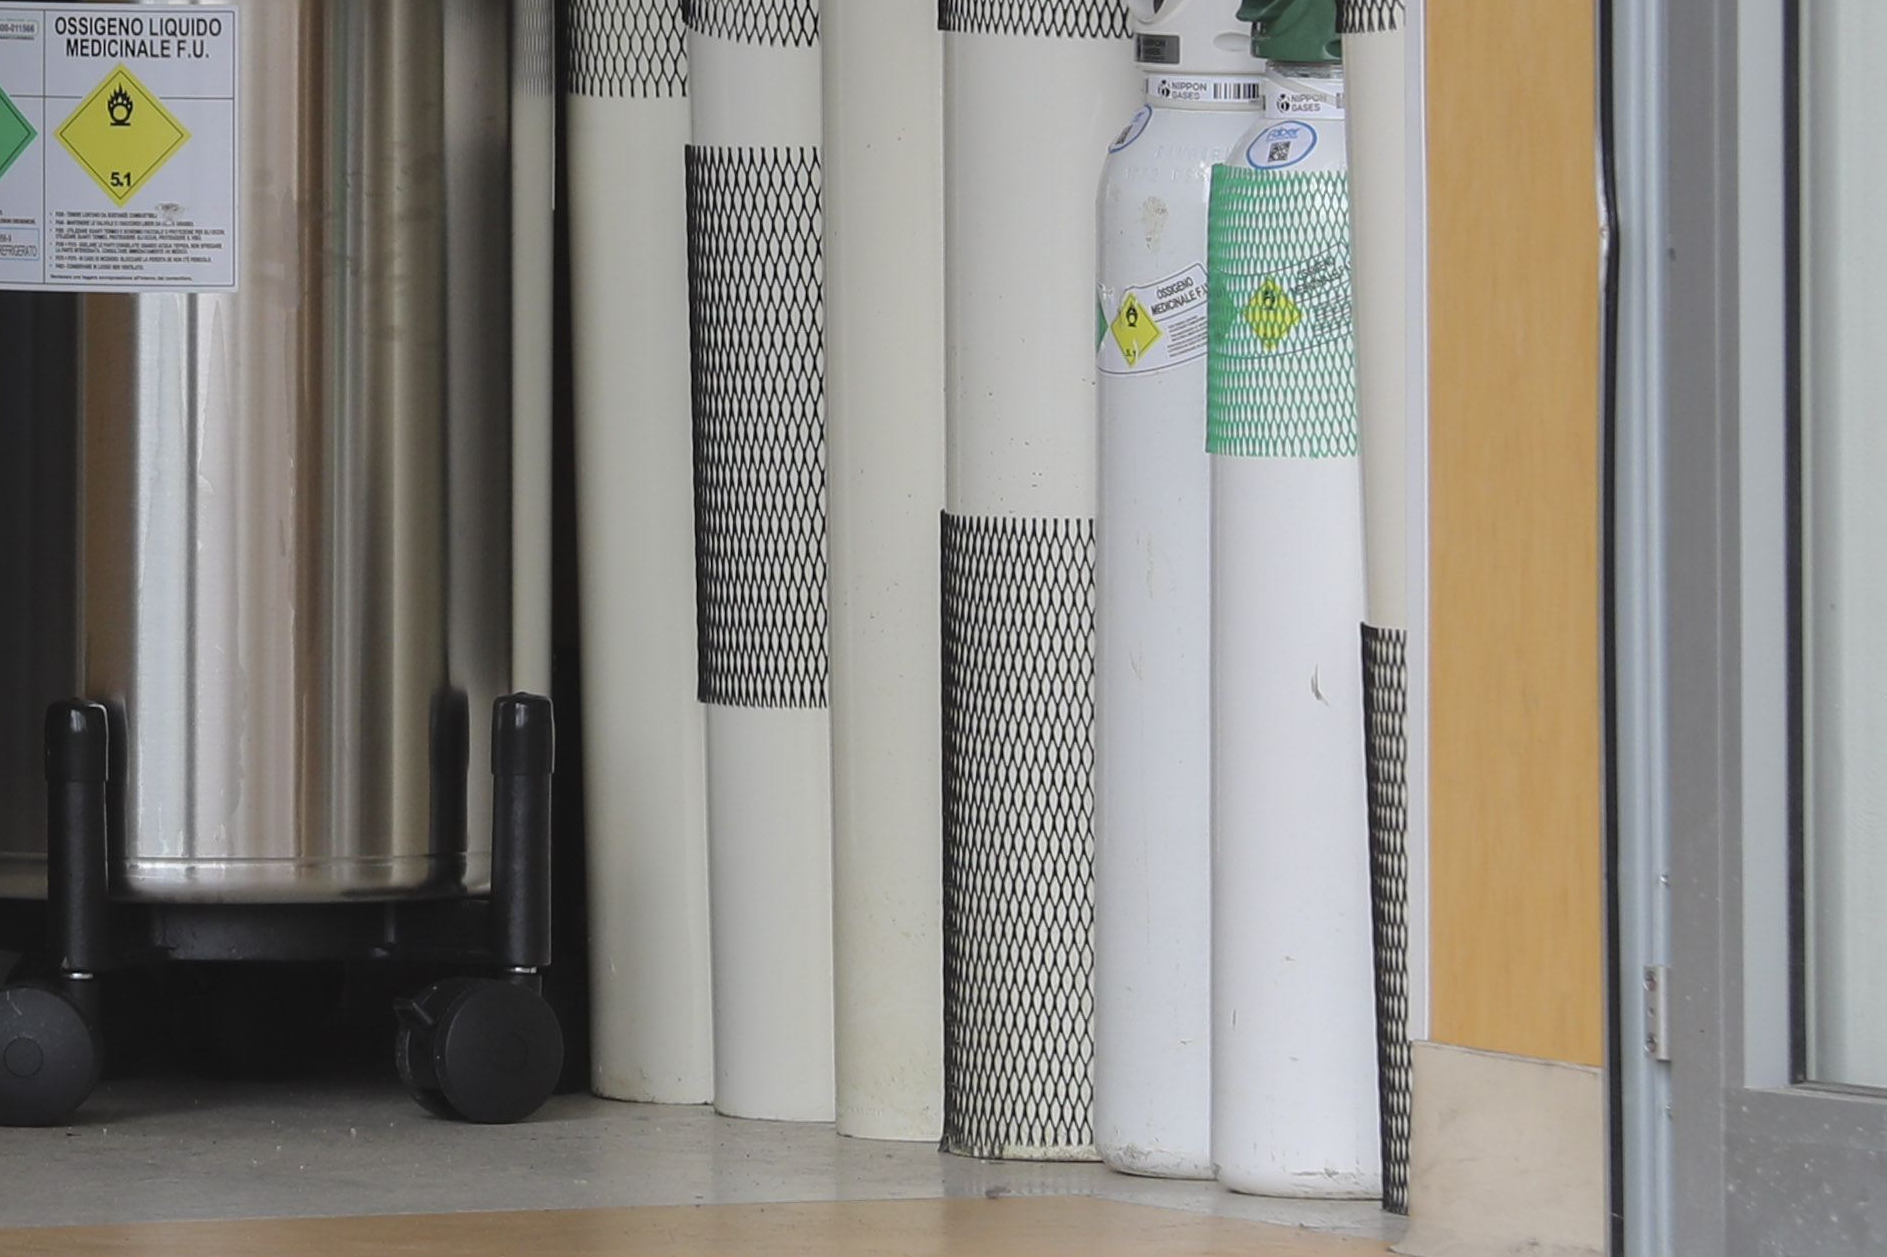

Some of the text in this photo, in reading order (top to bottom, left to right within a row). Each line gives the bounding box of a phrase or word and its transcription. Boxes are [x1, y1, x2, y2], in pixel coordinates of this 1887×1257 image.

[55, 17, 222, 37] OSSIGENO LIQUIDO
[66, 39, 210, 59] MEDICINALE F.U.
[1172, 82, 1207, 91] NIPPON
[1171, 91, 1201, 100] GASES
[1291, 94, 1327, 103] NIPPON
[1291, 103, 1321, 112] GASES
[110, 172, 132, 187] 5.1
[1156, 276, 1194, 300] OSSIGENO
[1151, 290, 1197, 315] MEDICINALE
